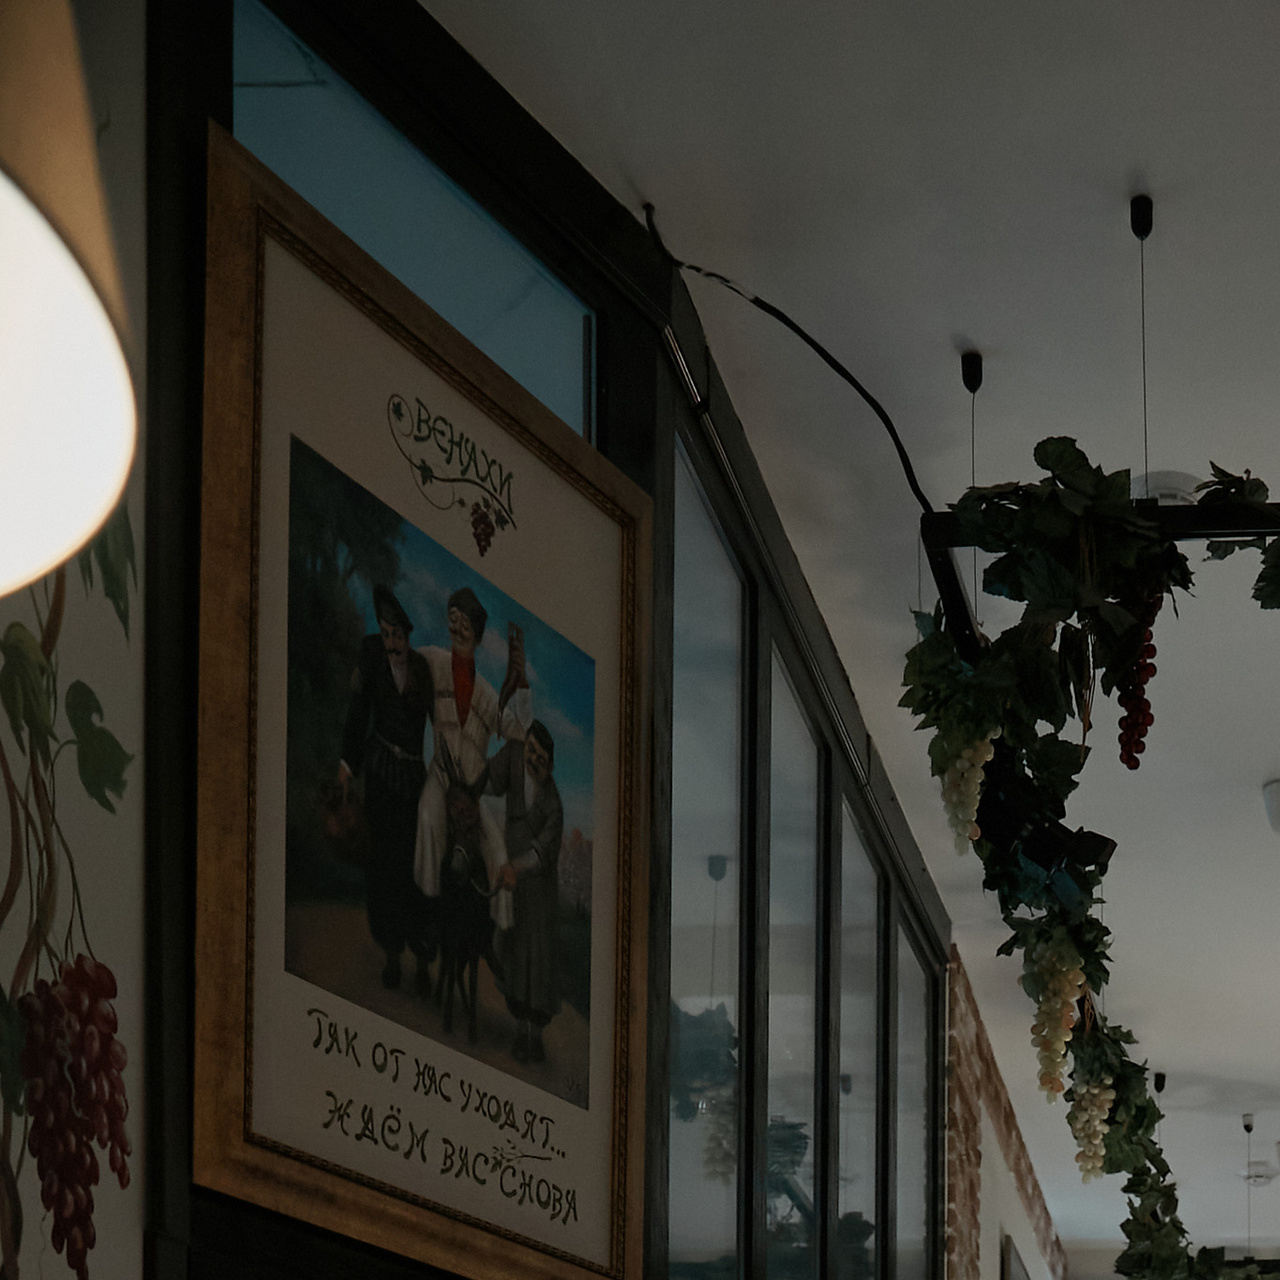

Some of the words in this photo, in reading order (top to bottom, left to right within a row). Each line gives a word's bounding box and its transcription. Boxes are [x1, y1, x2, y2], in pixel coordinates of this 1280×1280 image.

[307, 1008, 361, 1067] ТАК
[371, 1042, 405, 1083] ОТ
[413, 1058, 452, 1102] НАС
[322, 1090, 429, 1162] ЖДЁМ
[440, 1137, 487, 1185] ВАС
[499, 1165, 578, 1225] СНОВА
